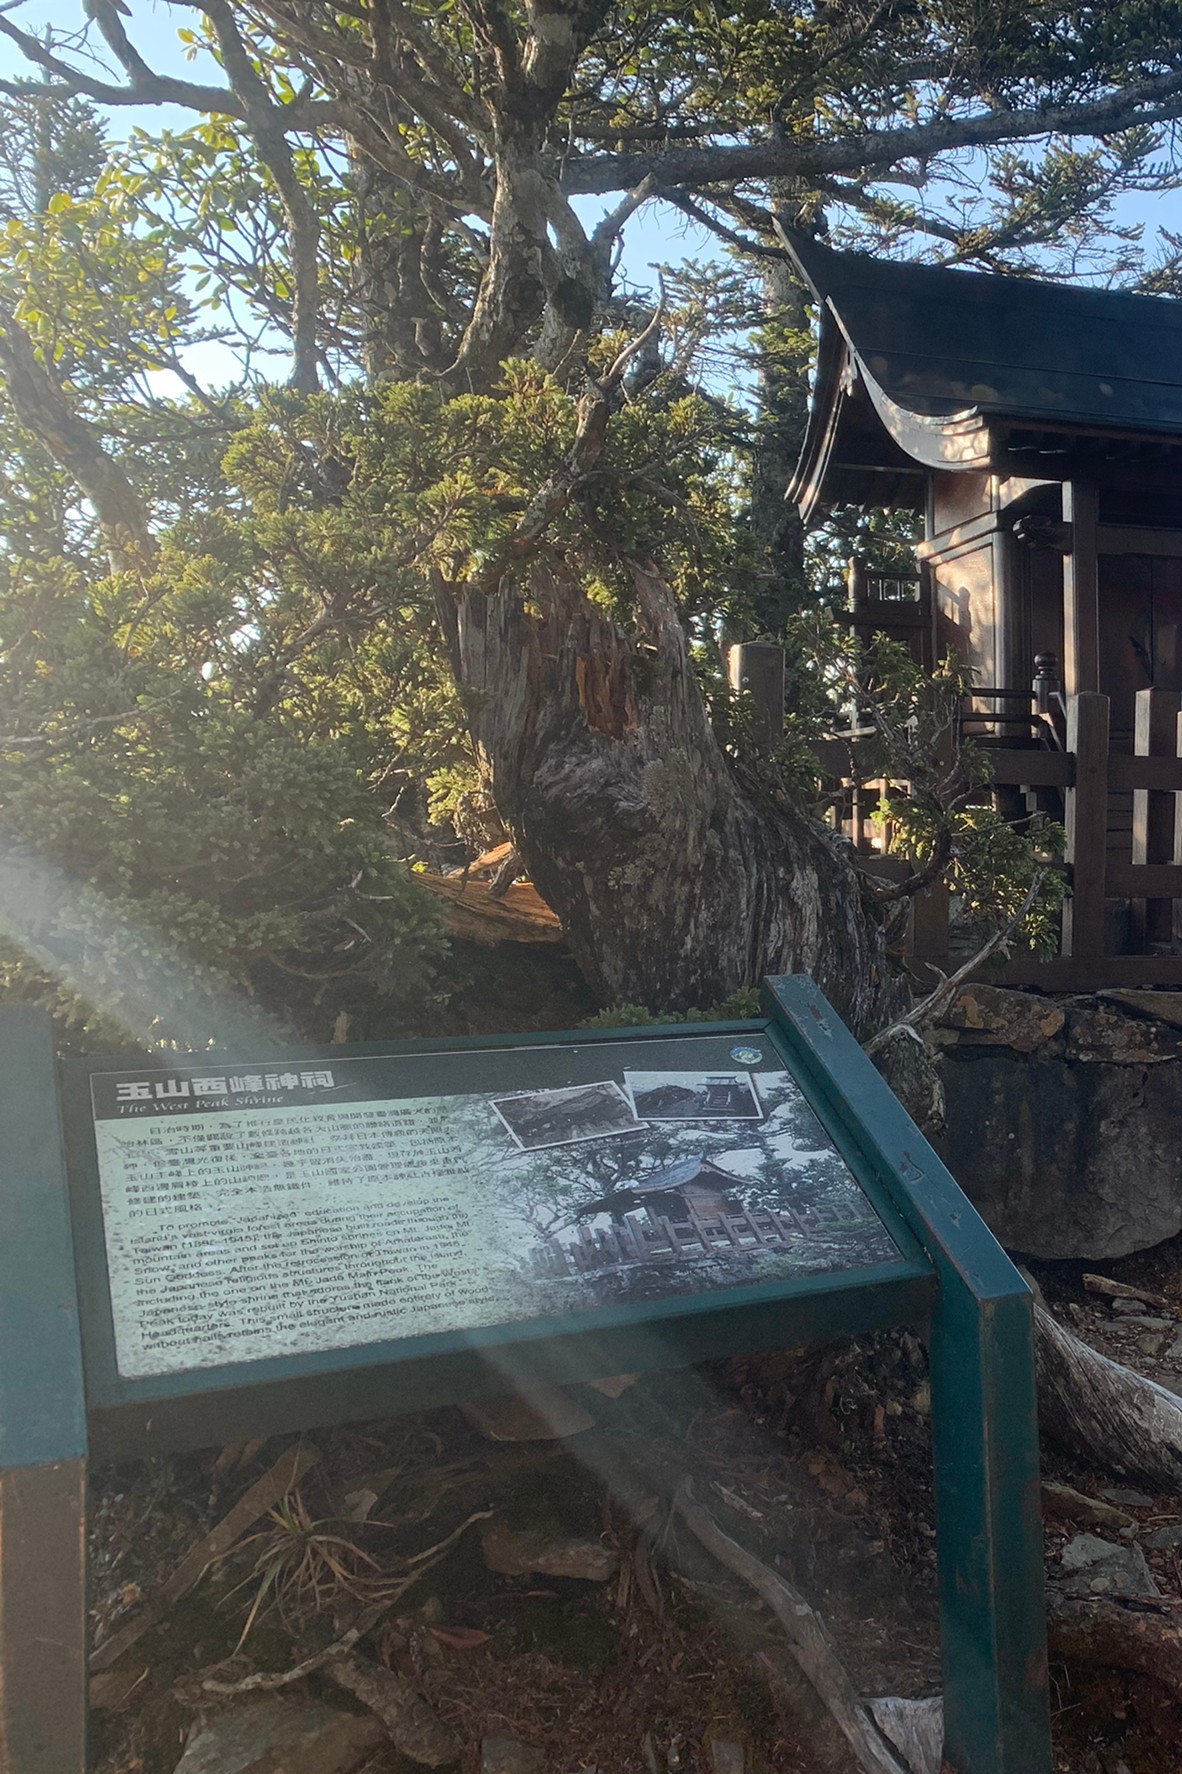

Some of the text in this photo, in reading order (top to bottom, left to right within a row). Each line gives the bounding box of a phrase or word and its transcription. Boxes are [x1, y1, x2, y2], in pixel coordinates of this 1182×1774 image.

[116, 1070, 335, 1101] 玉山西峰神祠
[118, 1095, 284, 1115] The West Peak Shrine
